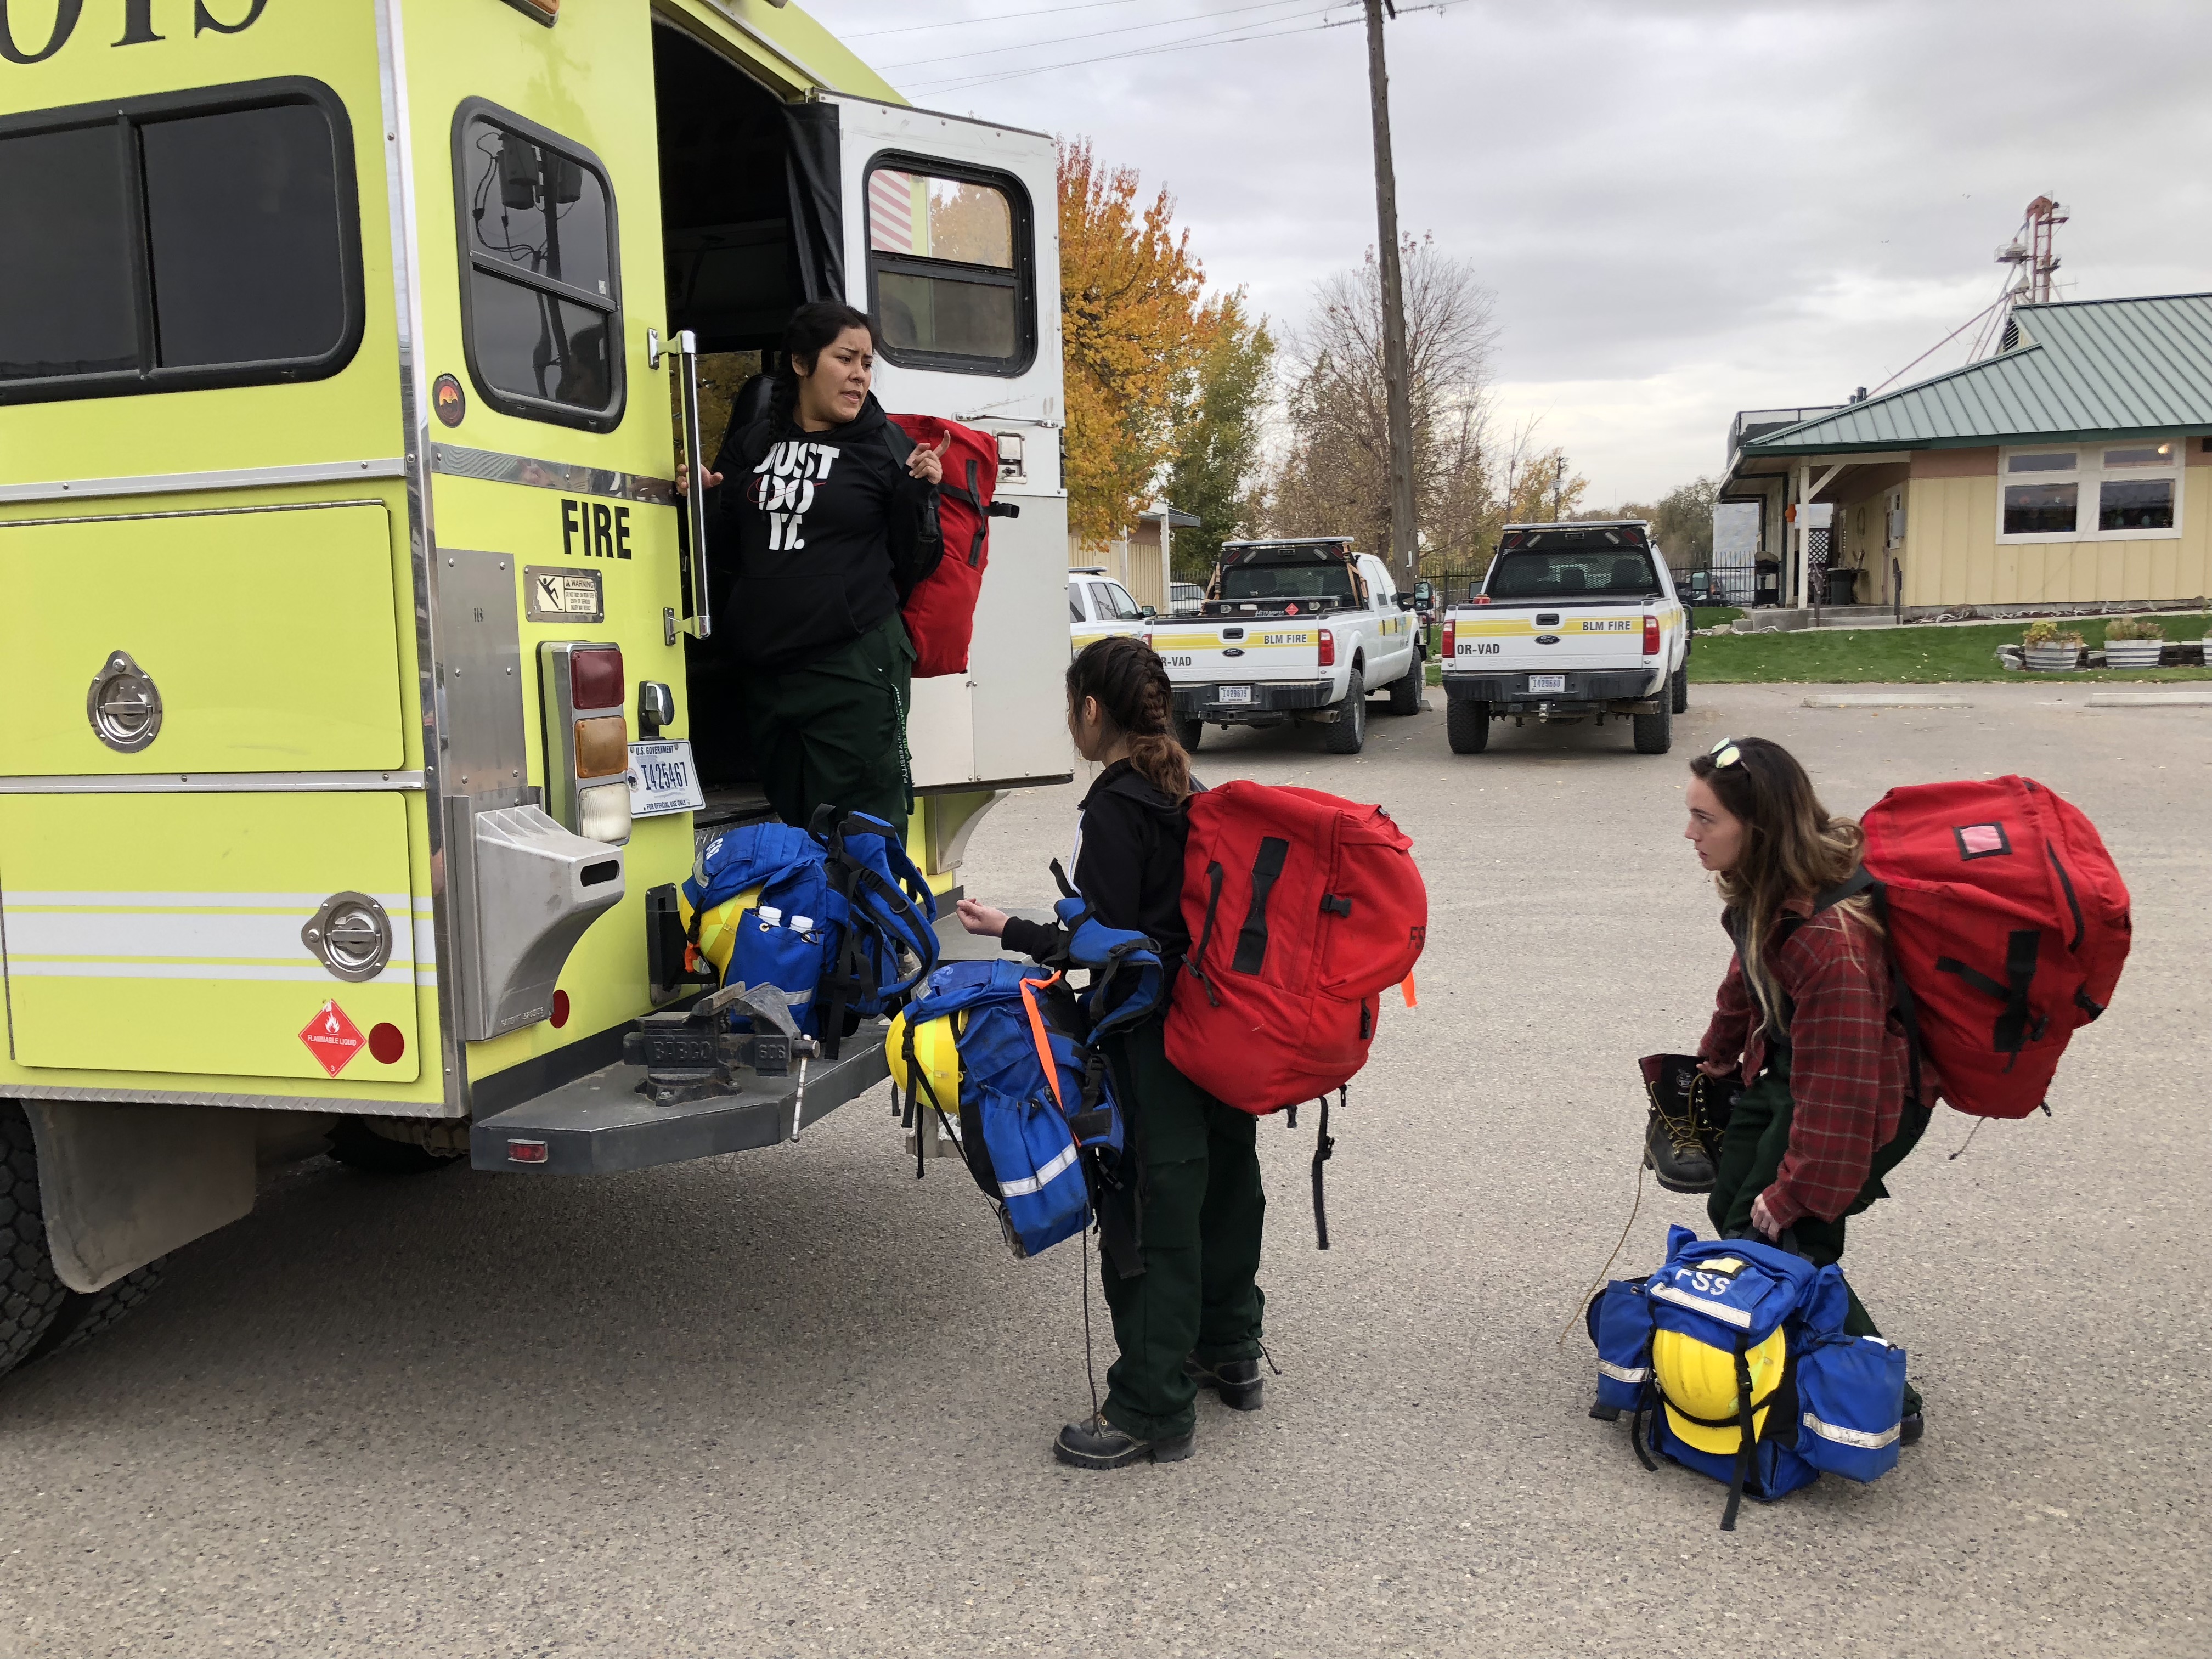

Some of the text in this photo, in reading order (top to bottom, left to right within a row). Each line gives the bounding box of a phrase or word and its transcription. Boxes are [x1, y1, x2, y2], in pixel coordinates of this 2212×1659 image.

[753, 441, 840, 478] JUST
[759, 475, 814, 514] DO
[561, 499, 632, 560] FIRE
[769, 512, 805, 550] IT.
[572, 579, 594, 588] WARNING
[1583, 620, 1630, 631] BLM FIRE
[1264, 634, 1307, 644] BLM FIRE
[1457, 644, 1500, 655] OR-VAD
[1161, 656, 1192, 667] R-VAD
[1223, 689, 1247, 697] I429679
[636, 745, 674, 755] U.S. GOVERNMENT
[641, 761, 688, 791] I425467
[654, 802, 669, 810] OFFICIAL
[307, 1034, 357, 1046] FLAMMABLE LIQUID
